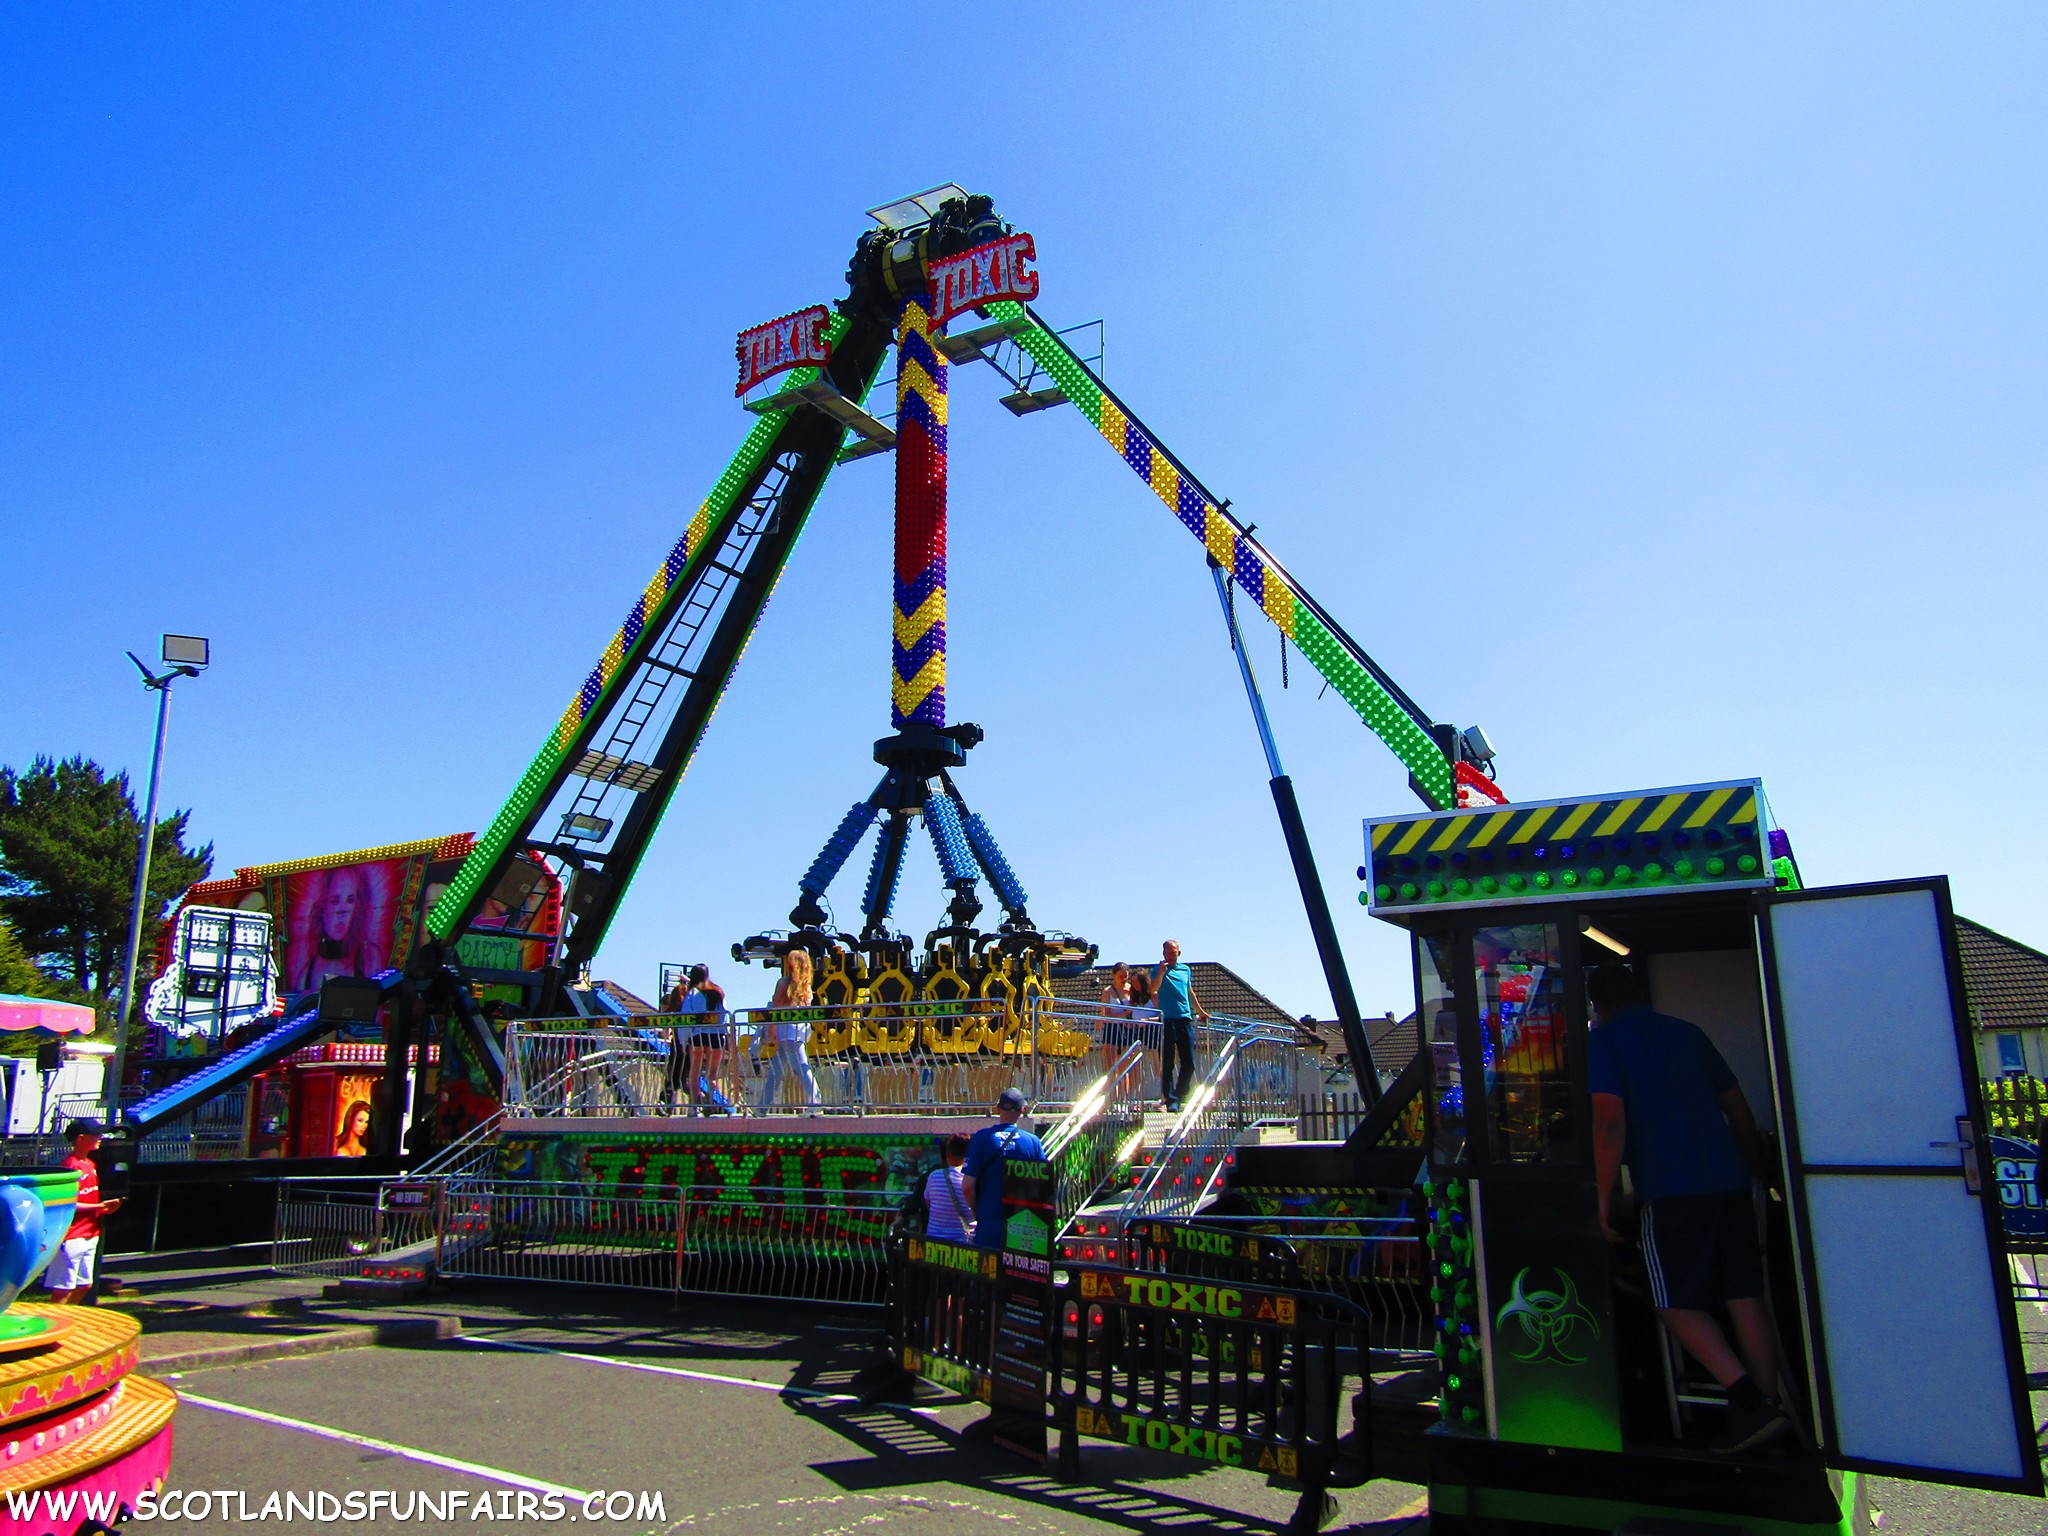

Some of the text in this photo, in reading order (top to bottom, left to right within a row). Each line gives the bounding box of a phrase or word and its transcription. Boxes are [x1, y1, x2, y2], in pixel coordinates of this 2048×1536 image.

[932, 240, 1034, 321] TOXIC
[740, 311, 828, 385] TOXIC
[462, 939, 513, 969] PARTY
[647, 1013, 697, 1027] TOXIC
[769, 1008, 825, 1022] TOXIC
[903, 1002, 964, 1016] TOXIC
[543, 1019, 588, 1031] TOXIC
[1005, 1159, 1050, 1180] TOXIC
[1174, 1227, 1233, 1256] TOXIC
[925, 1241, 980, 1274] ENTRANCE
[1002, 1251, 1051, 1275] FOR YOUR SAFETY
[1123, 1276, 1242, 1318] TOXIC
[923, 1352, 971, 1395] TOXIC
[1121, 1414, 1242, 1465] TOXIC
